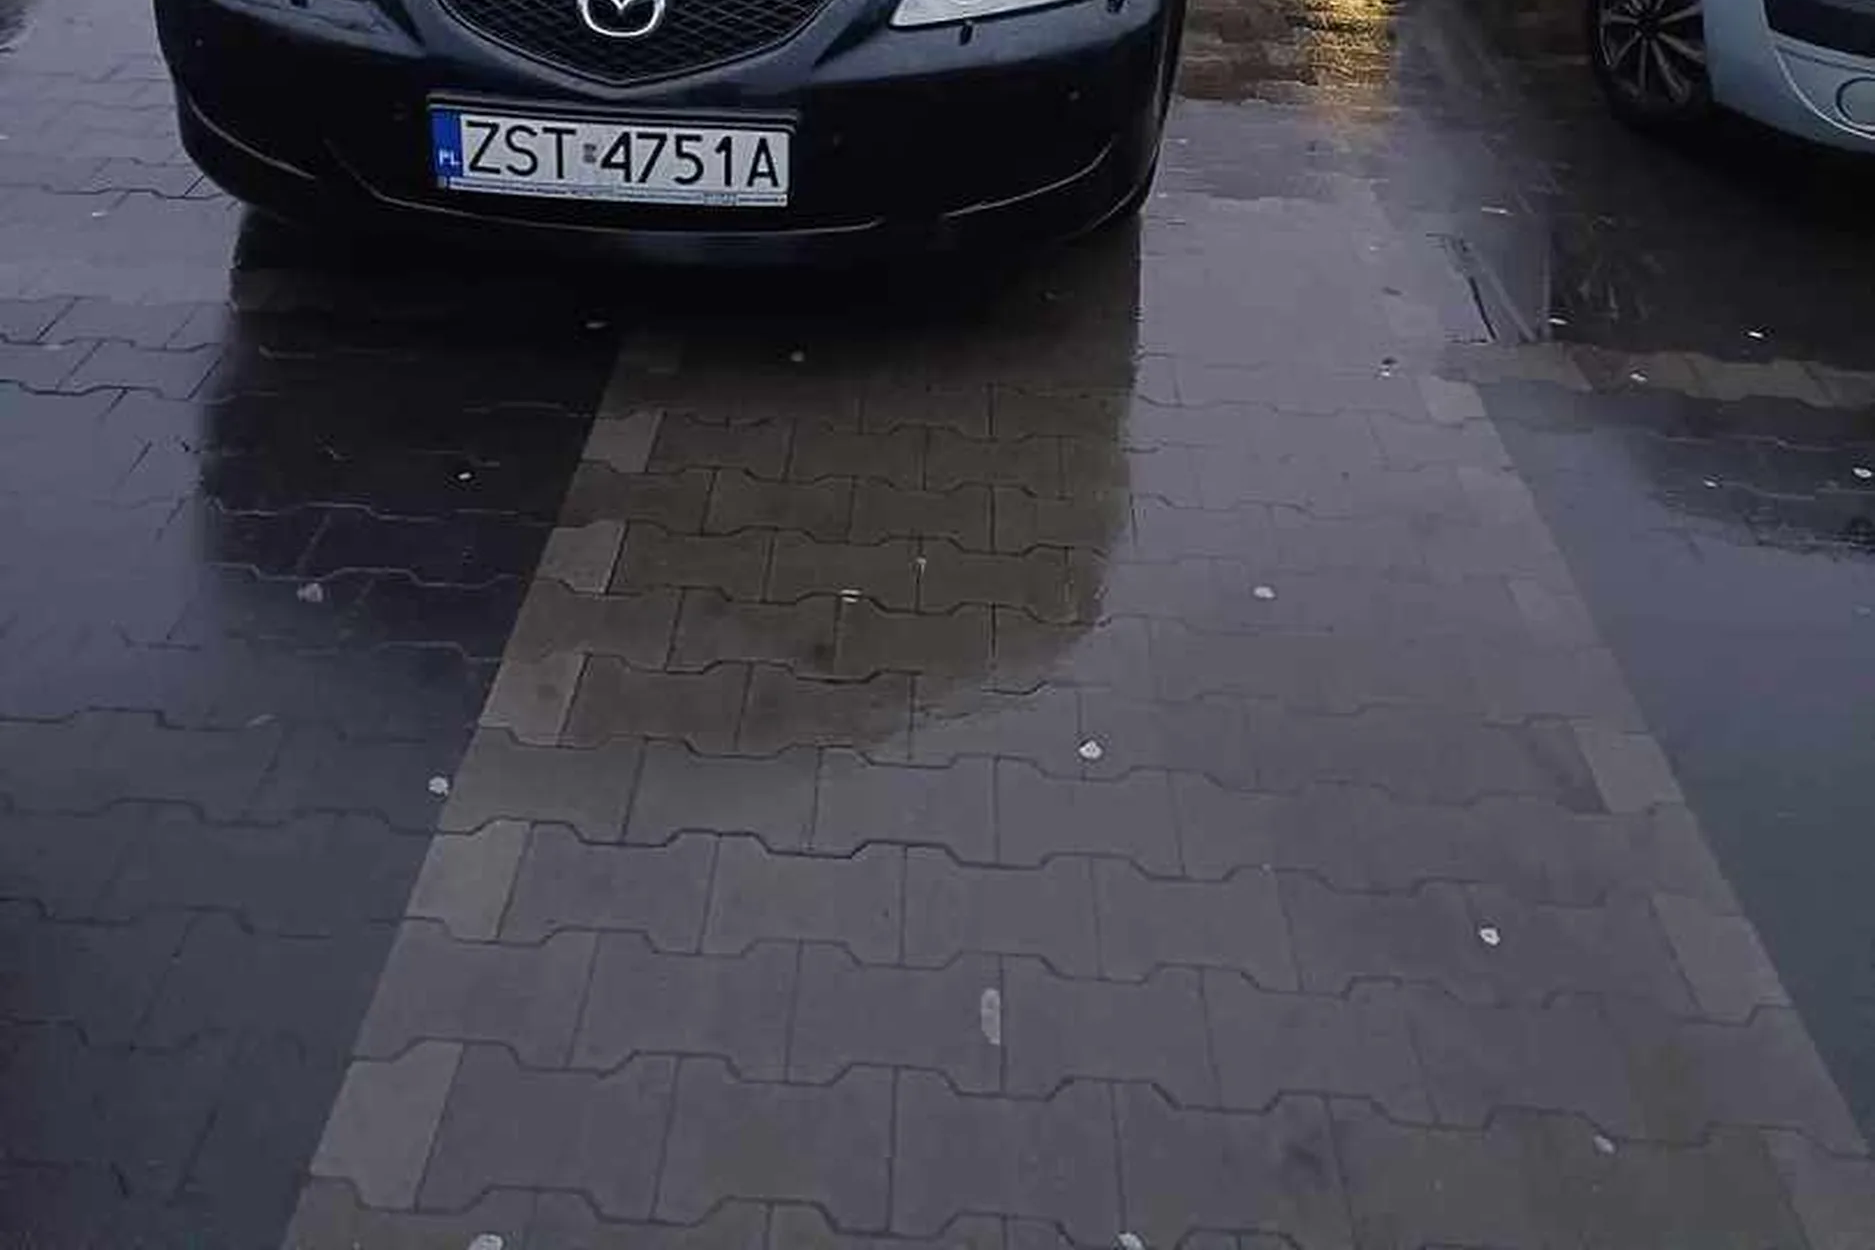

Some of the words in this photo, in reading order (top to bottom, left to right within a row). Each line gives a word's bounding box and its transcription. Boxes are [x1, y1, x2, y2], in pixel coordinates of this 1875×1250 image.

[438, 150, 461, 166] PL
[465, 119, 578, 180] ZST
[600, 130, 780, 189] 4751A
